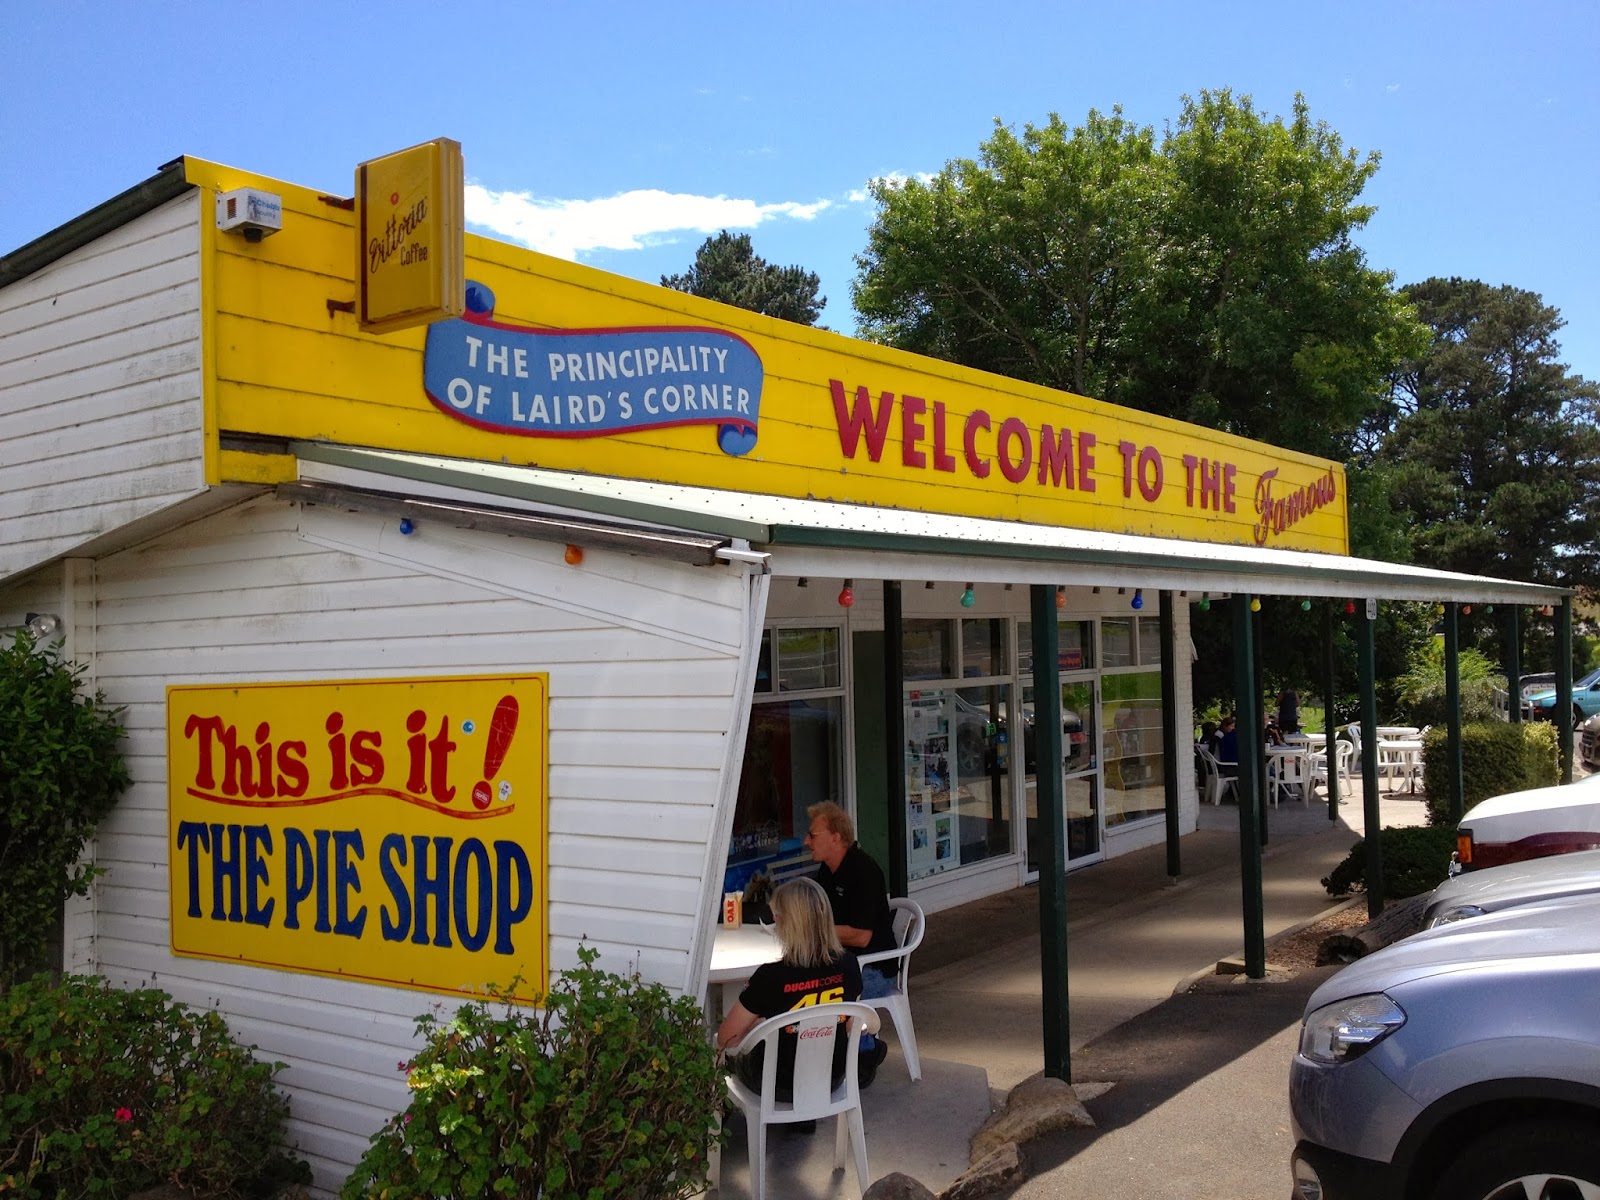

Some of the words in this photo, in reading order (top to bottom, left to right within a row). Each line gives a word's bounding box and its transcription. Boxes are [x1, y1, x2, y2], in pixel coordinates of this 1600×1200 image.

[256, 199, 280, 211] Chubb
[400, 242, 428, 266] Coffee
[466, 335, 529, 379] THE
[548, 345, 728, 382] PRINCIPALITY
[447, 377, 492, 415] OF
[512, 390, 632, 425] LAIRD'S
[643, 384, 750, 415] CORNER
[829, 379, 1097, 493] WELCOME
[1119, 440, 1164, 502] TO
[1183, 454, 1237, 514] THE
[1253, 465, 1336, 547] Famous
[185, 713, 310, 798] This
[325, 711, 385, 791] is
[177, 820, 276, 929] THE
[283, 826, 367, 939] PIE
[380, 833, 533, 955] SHOP
[727, 900, 735, 923] OAK
